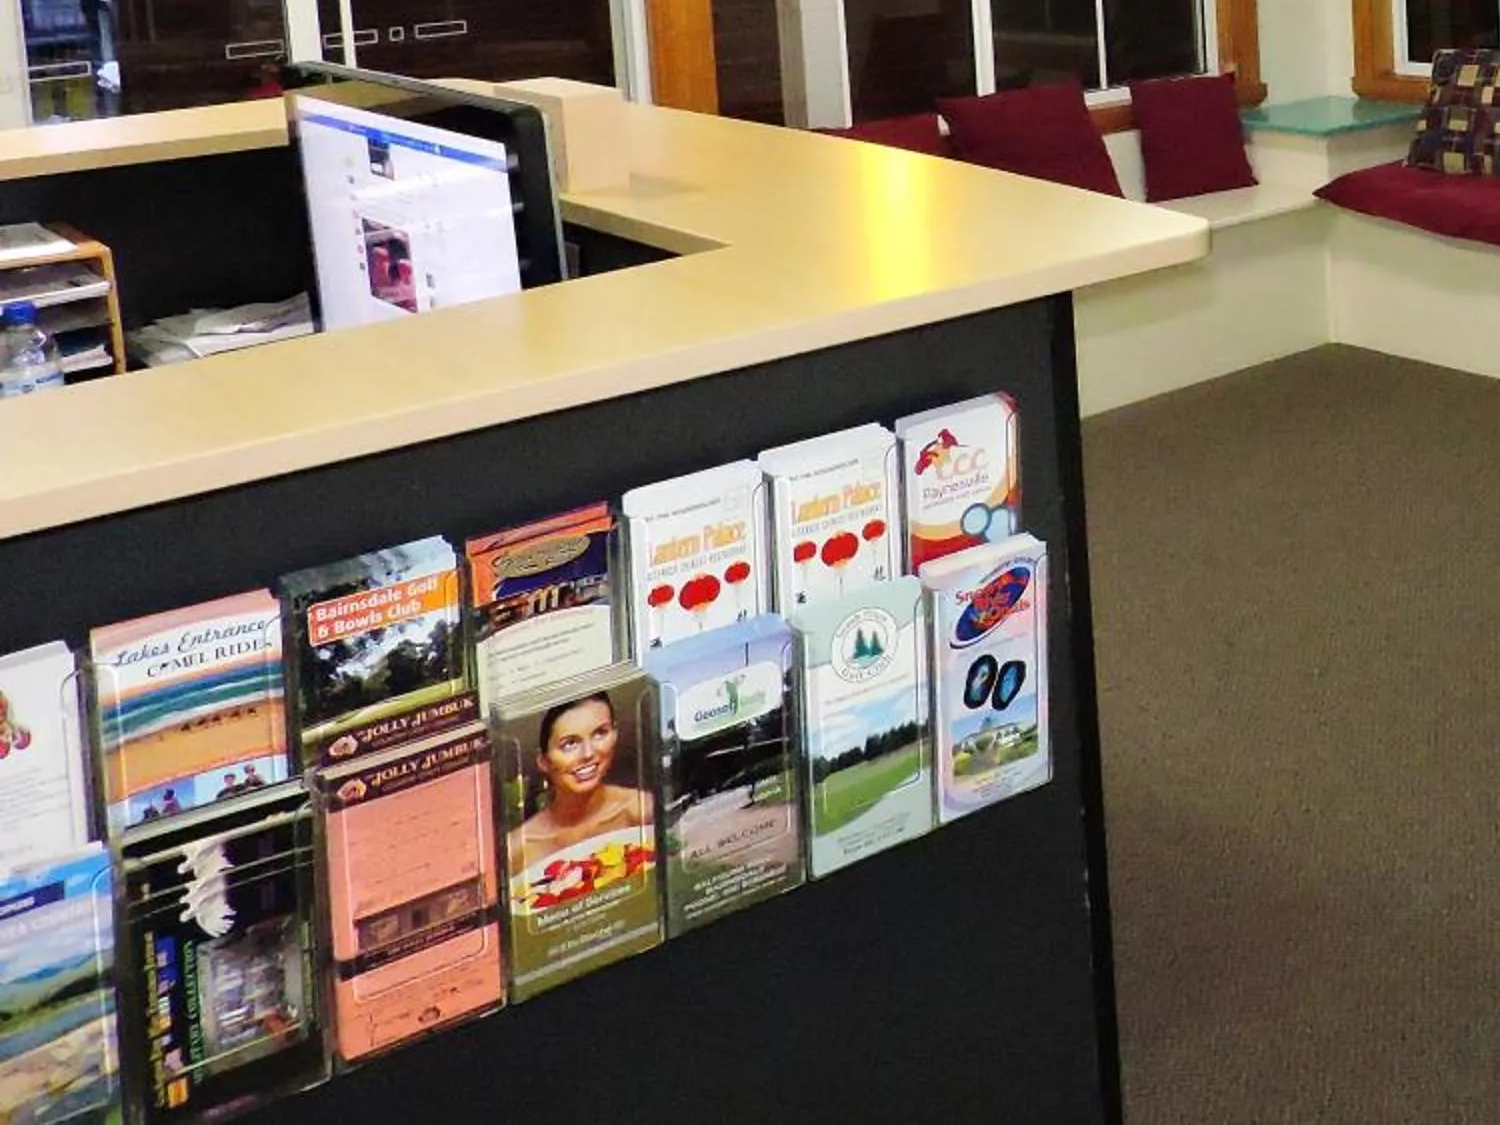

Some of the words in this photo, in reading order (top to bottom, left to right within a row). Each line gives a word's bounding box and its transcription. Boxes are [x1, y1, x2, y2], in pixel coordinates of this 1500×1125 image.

[315, 588, 402, 622] Bairnsdale
[407, 578, 438, 597] Golf
[333, 609, 383, 633] Bowls
[387, 600, 422, 619] Club
[114, 642, 171, 667] Lakes
[177, 619, 268, 654] Entrance
[361, 716, 411, 743] JOLLY
[371, 759, 421, 787] JOLLY
